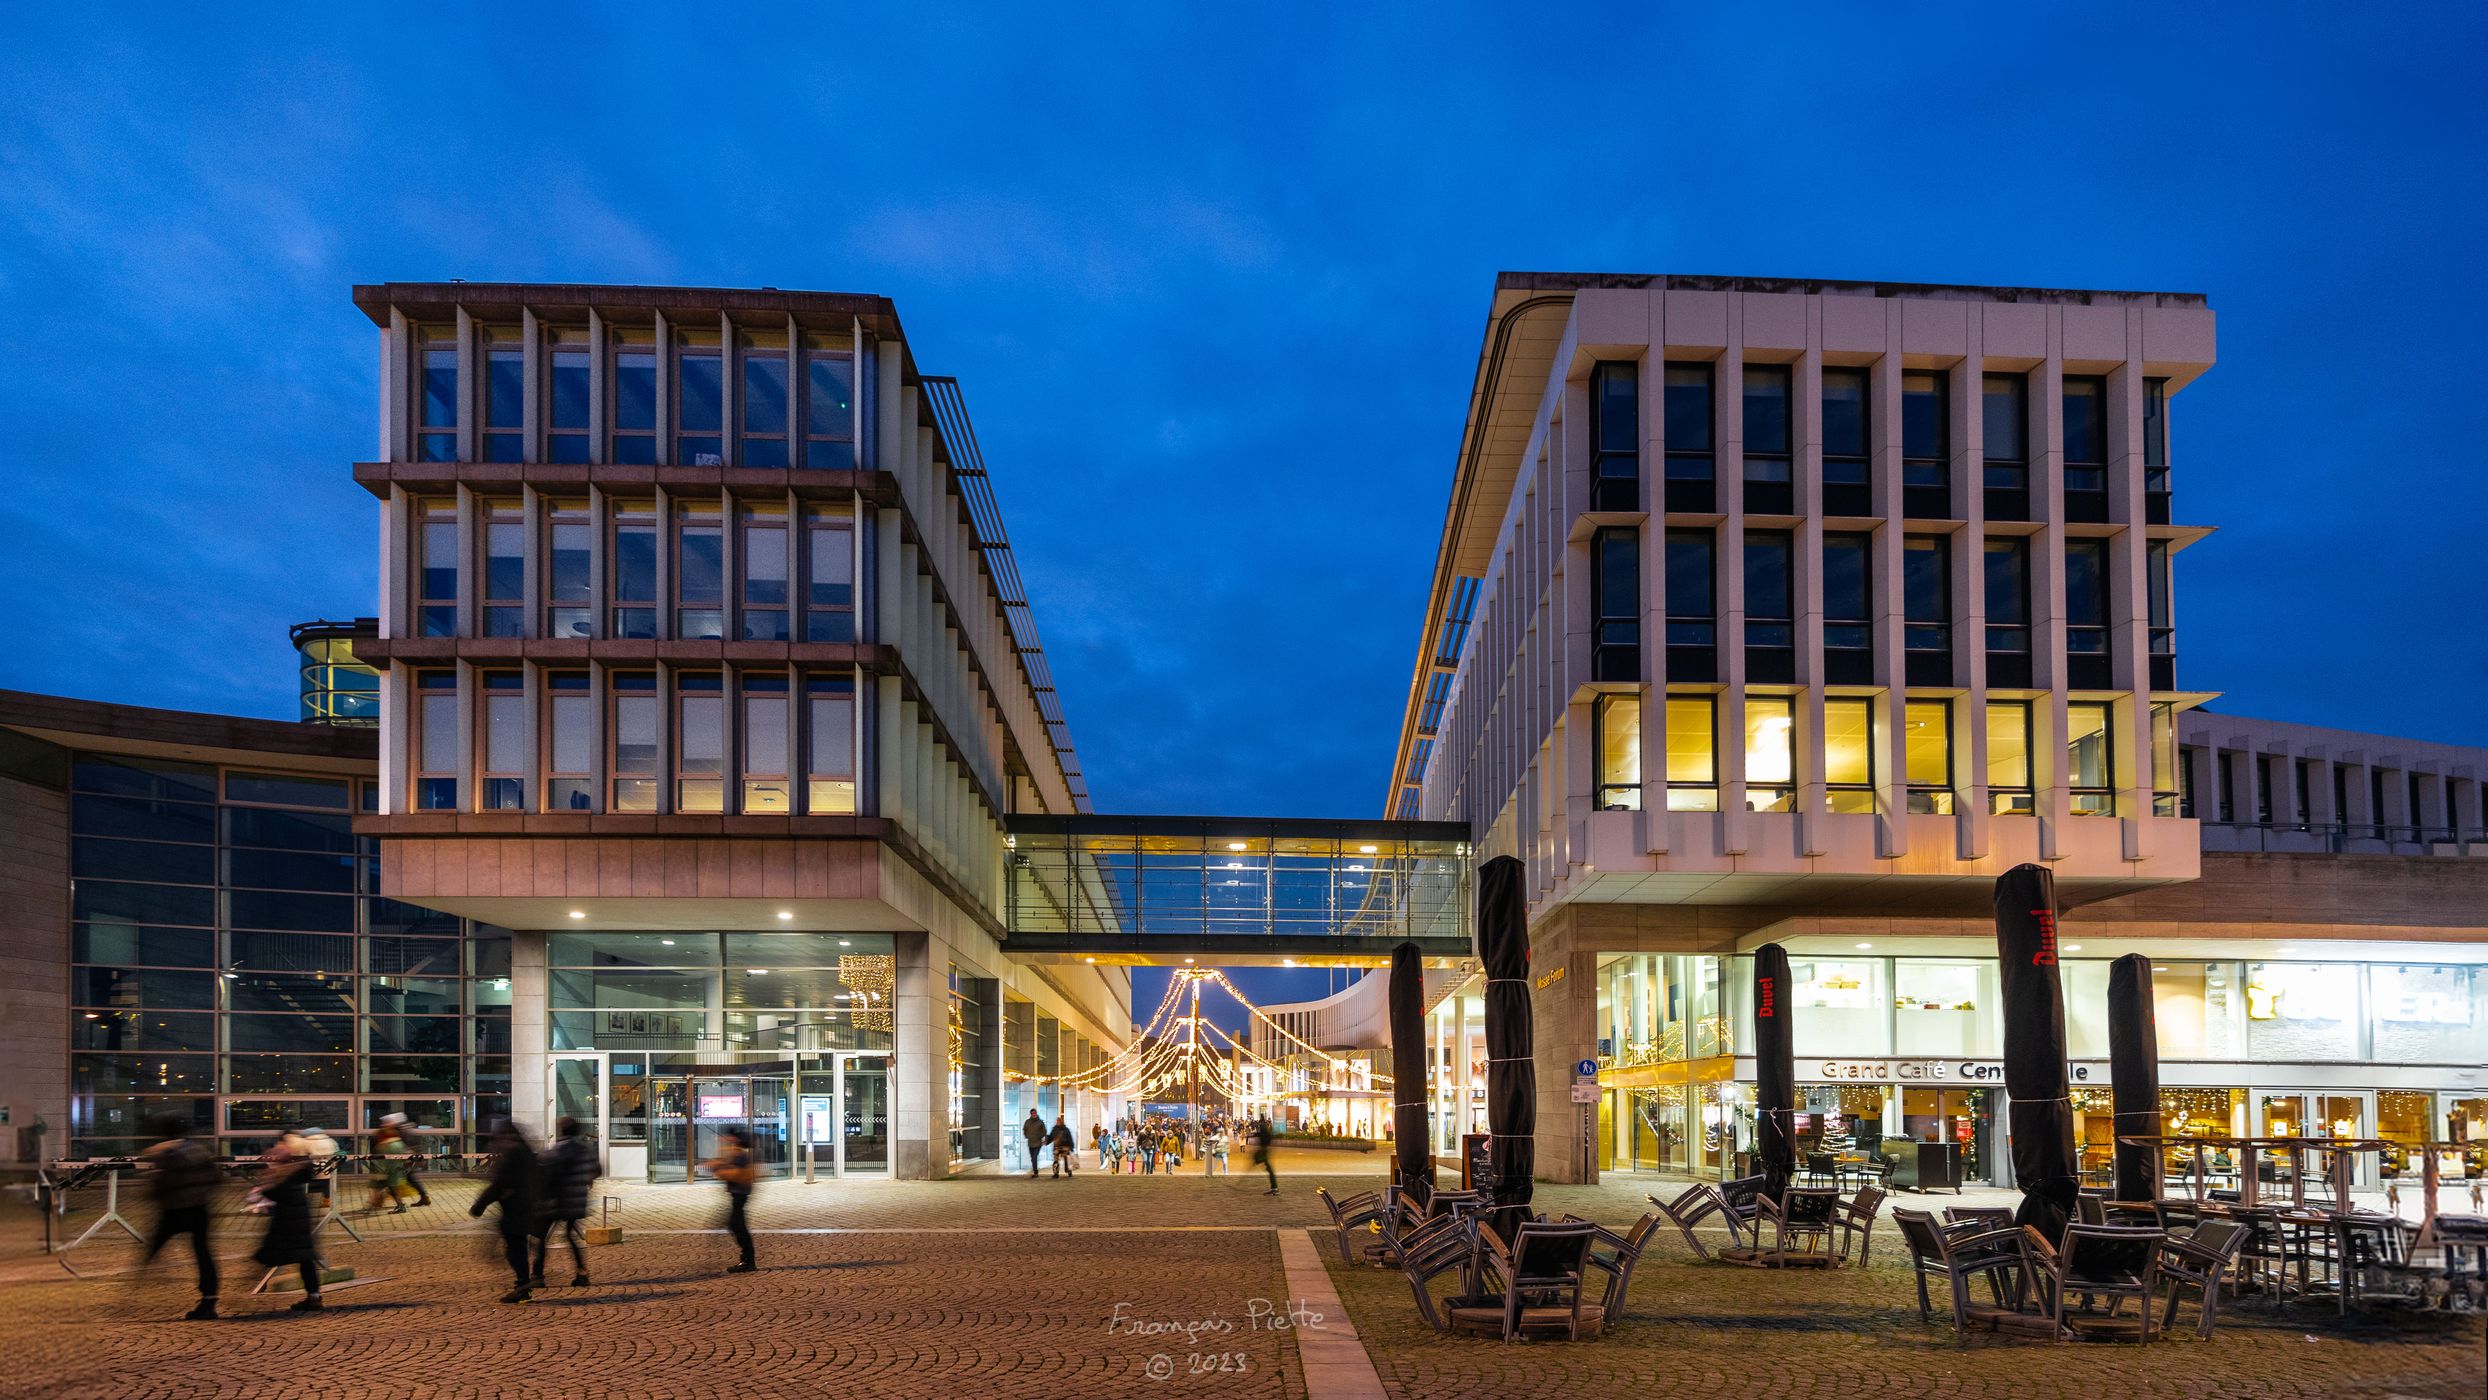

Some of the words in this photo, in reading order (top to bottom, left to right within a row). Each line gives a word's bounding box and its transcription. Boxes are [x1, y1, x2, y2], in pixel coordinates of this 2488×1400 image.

[2030, 908, 2057, 967] Duvel
[1759, 977, 1773, 1017] Duvel
[1822, 1061, 1889, 1079] Grand
[1897, 1060, 1946, 1079] Café
[1959, 1062, 2006, 1080] Cen
